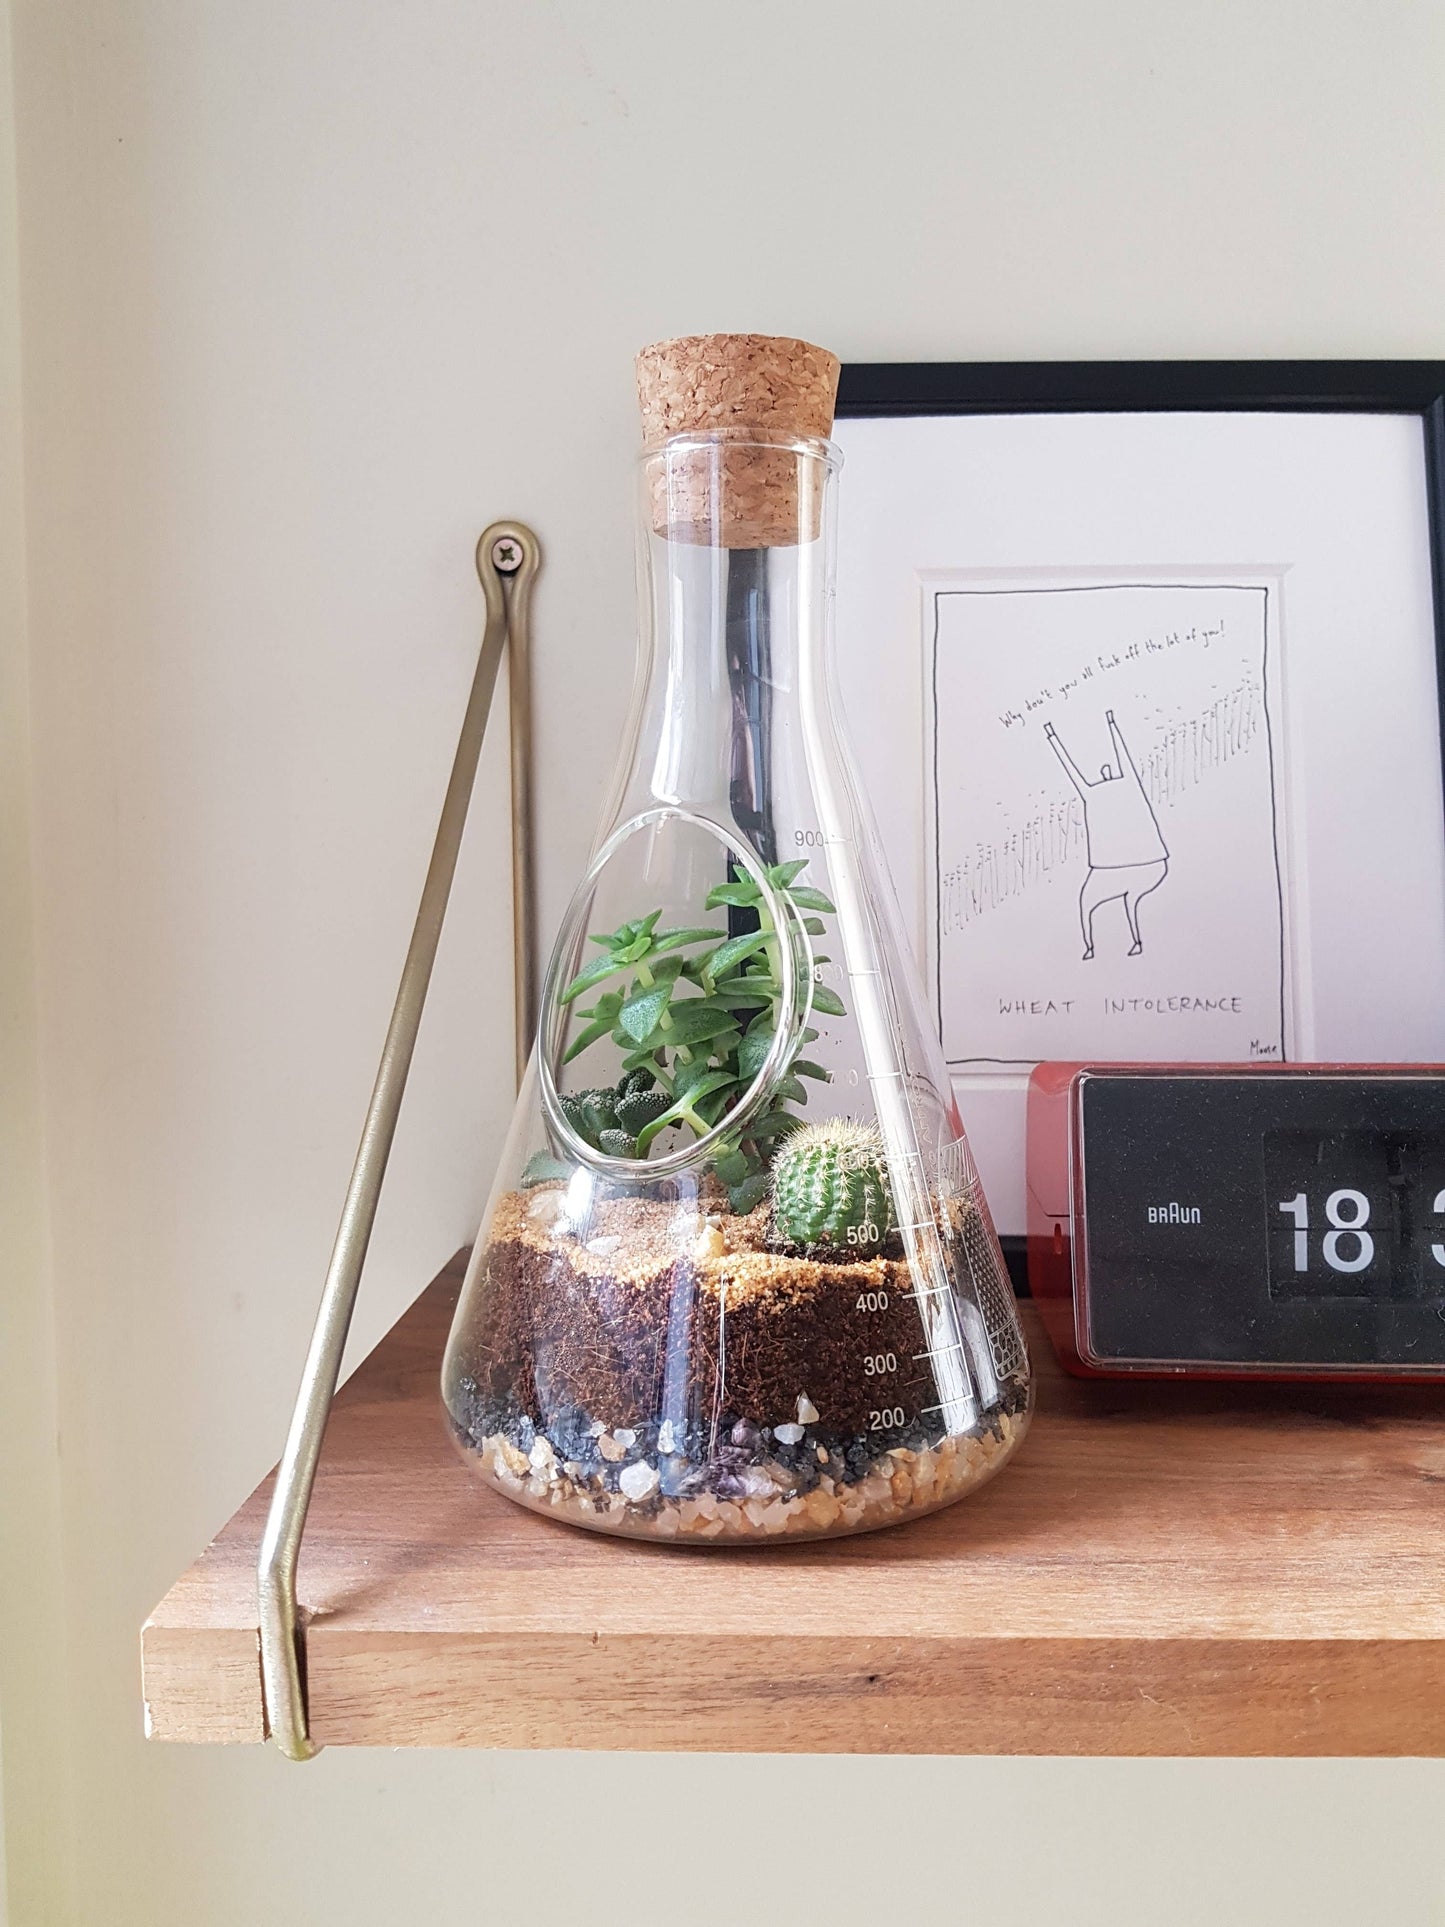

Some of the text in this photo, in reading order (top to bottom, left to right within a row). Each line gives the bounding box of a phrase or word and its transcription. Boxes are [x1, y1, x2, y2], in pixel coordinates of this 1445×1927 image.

[998, 619, 1226, 729] Why don't you all fuck off the lot of you!
[794, 830, 824, 847] 900
[999, 996, 1243, 1015] WHEAT INTOLERANCE
[1147, 1201, 1202, 1225] BRAUN
[846, 1223, 880, 1246] 500
[1278, 1188, 1375, 1274] 18
[855, 1290, 889, 1314] 400
[863, 1352, 898, 1376] 300
[869, 1406, 905, 1431] 200
